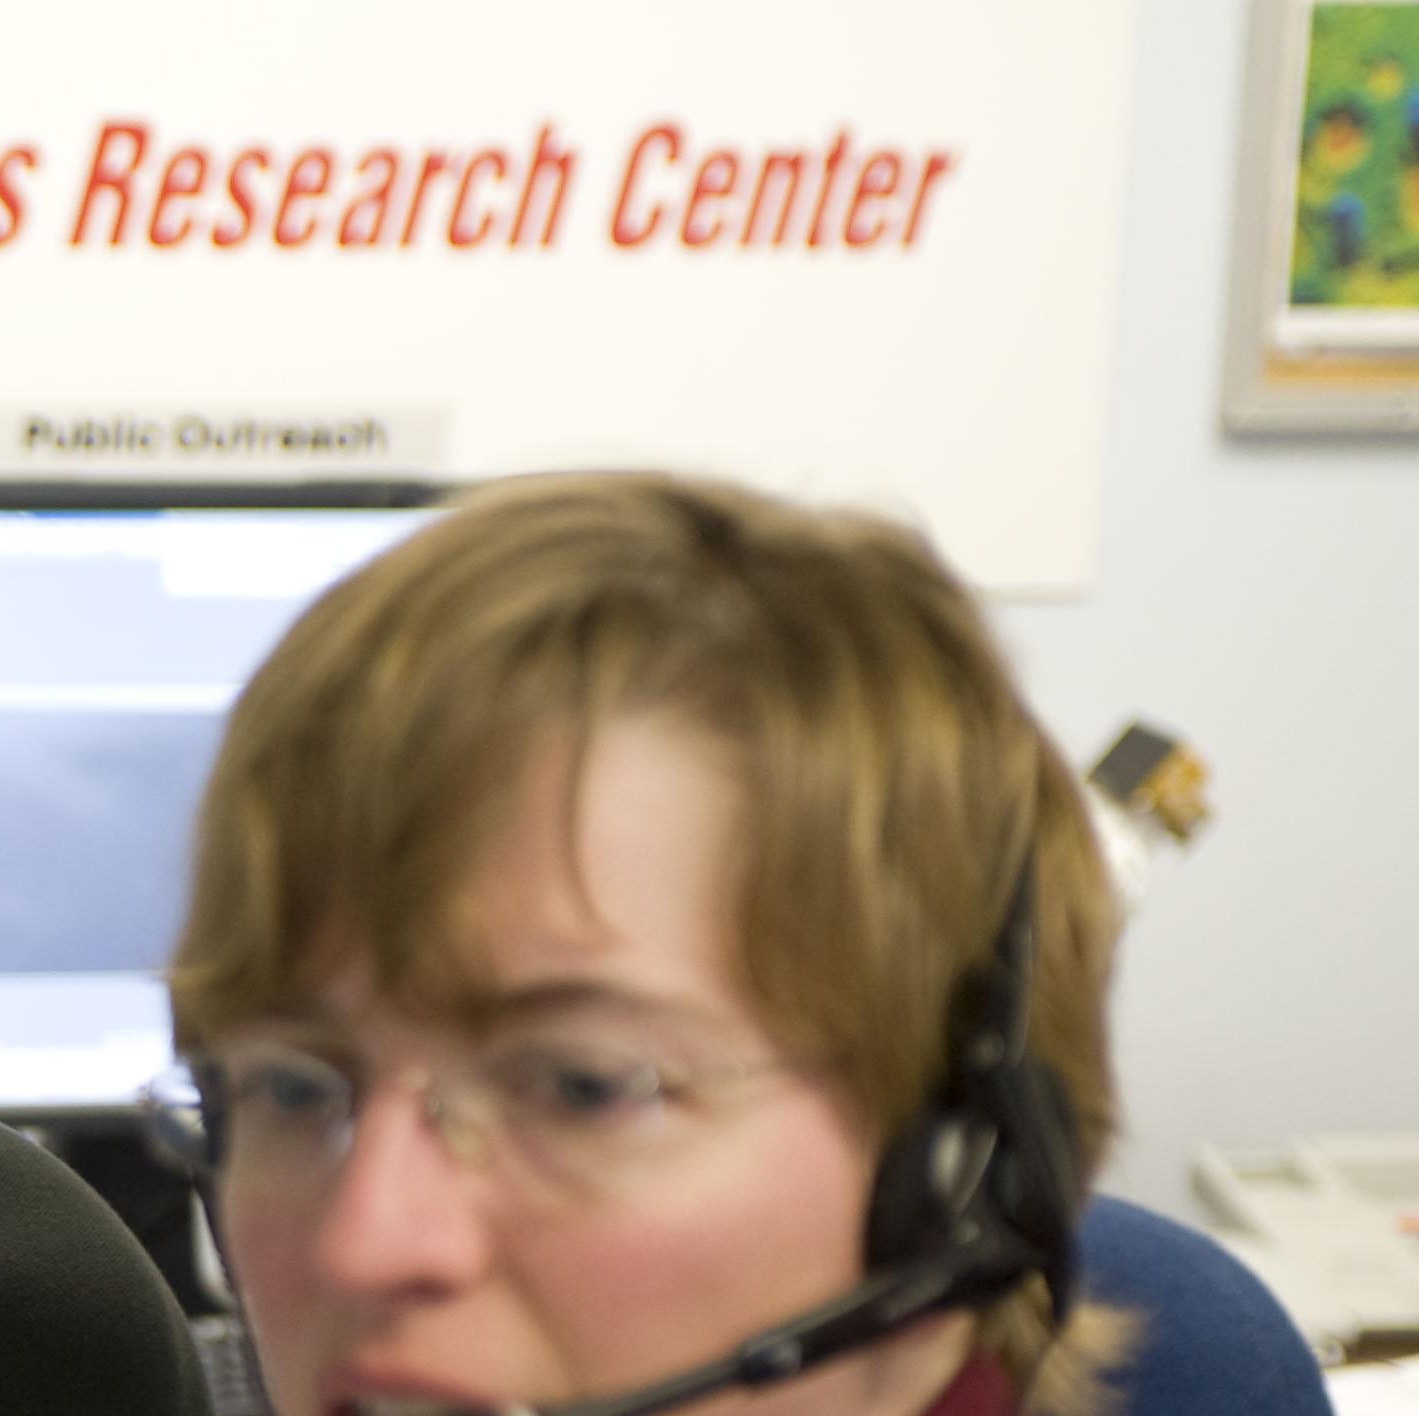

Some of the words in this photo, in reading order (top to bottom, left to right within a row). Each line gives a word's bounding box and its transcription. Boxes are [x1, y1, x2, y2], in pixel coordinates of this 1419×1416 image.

[70, 118, 576, 251] Research
[609, 123, 961, 251] Center
[23, 414, 159, 453] Public
[175, 414, 389, 453] Outreach
